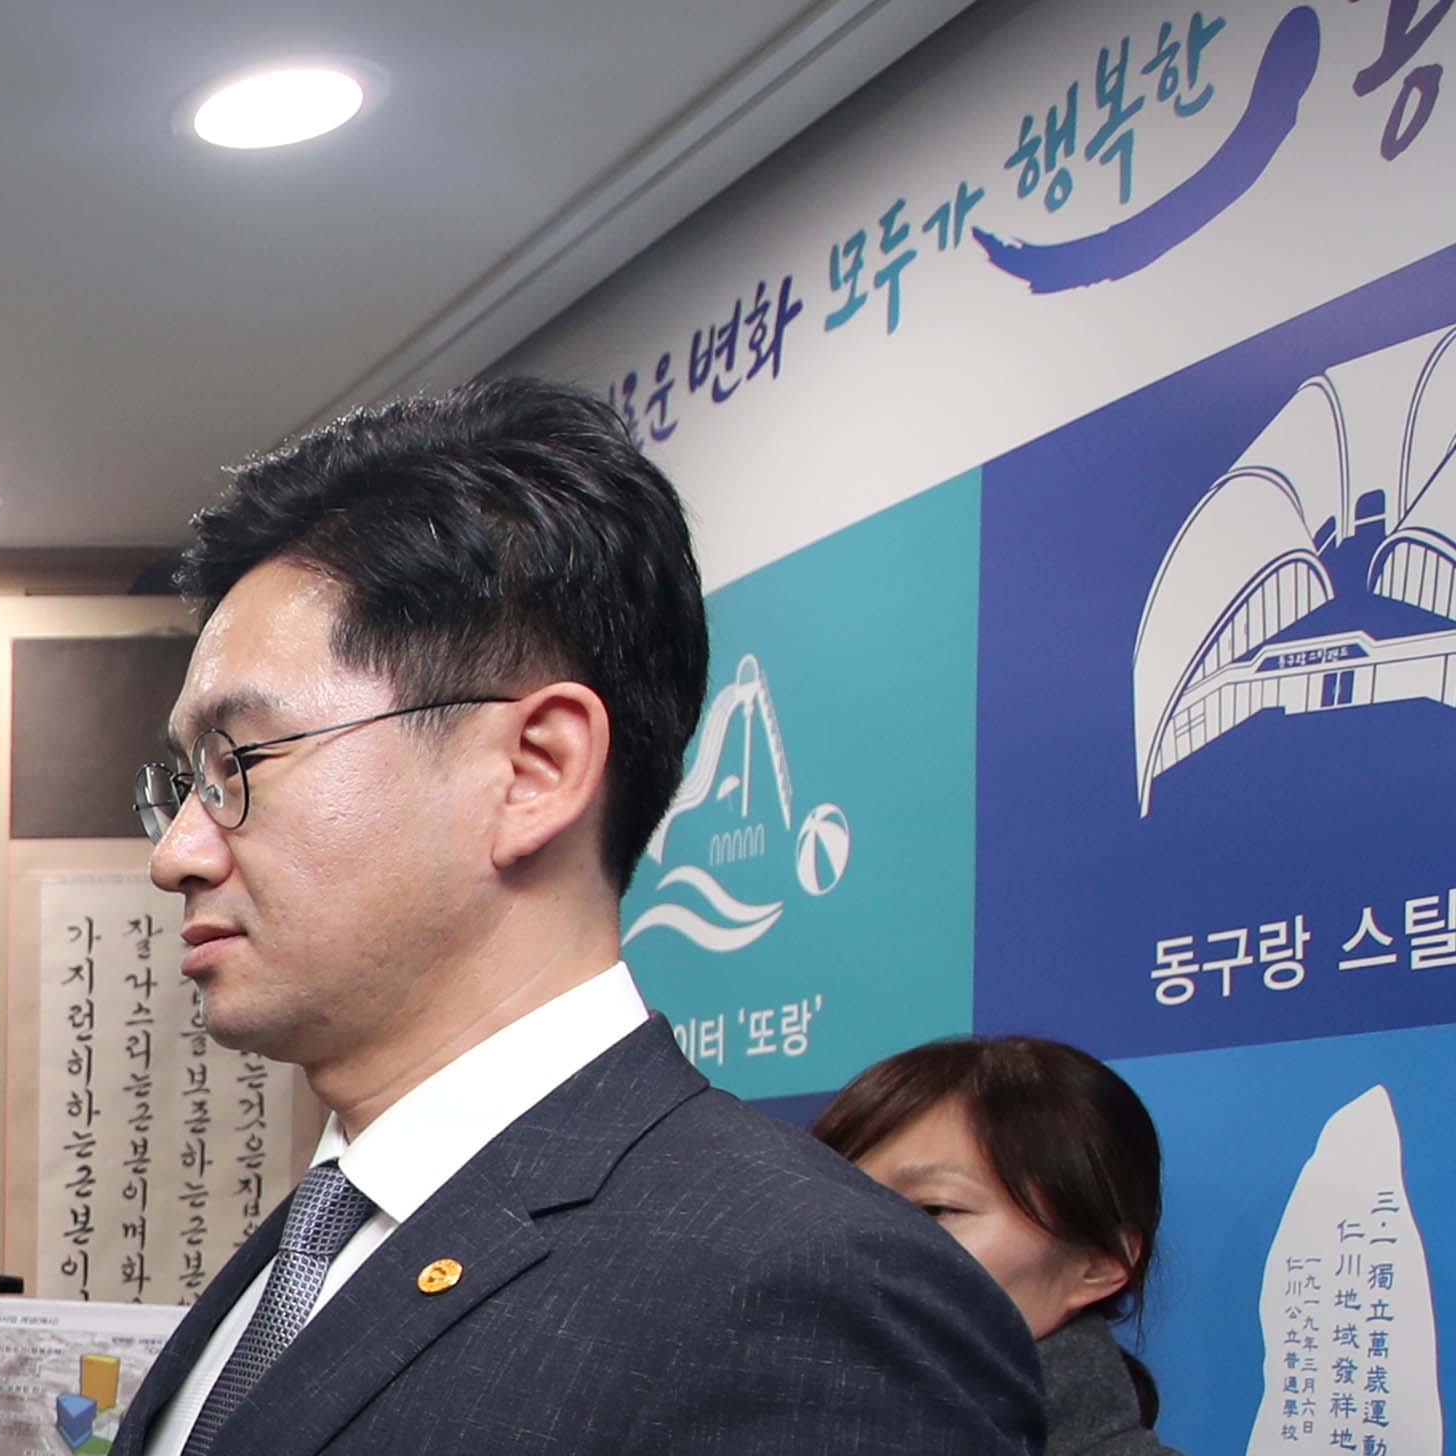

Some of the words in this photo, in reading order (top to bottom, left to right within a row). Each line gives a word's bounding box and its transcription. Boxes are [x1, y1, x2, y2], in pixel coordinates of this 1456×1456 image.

[609, 352, 678, 450] 로운
[689, 275, 803, 404] 변화
[824, 181, 985, 336] 모두가
[1004, 11, 1226, 213] 행복한
[1150, 914, 1311, 1006] 동구랑
[1338, 887, 1456, 971] 스틸
